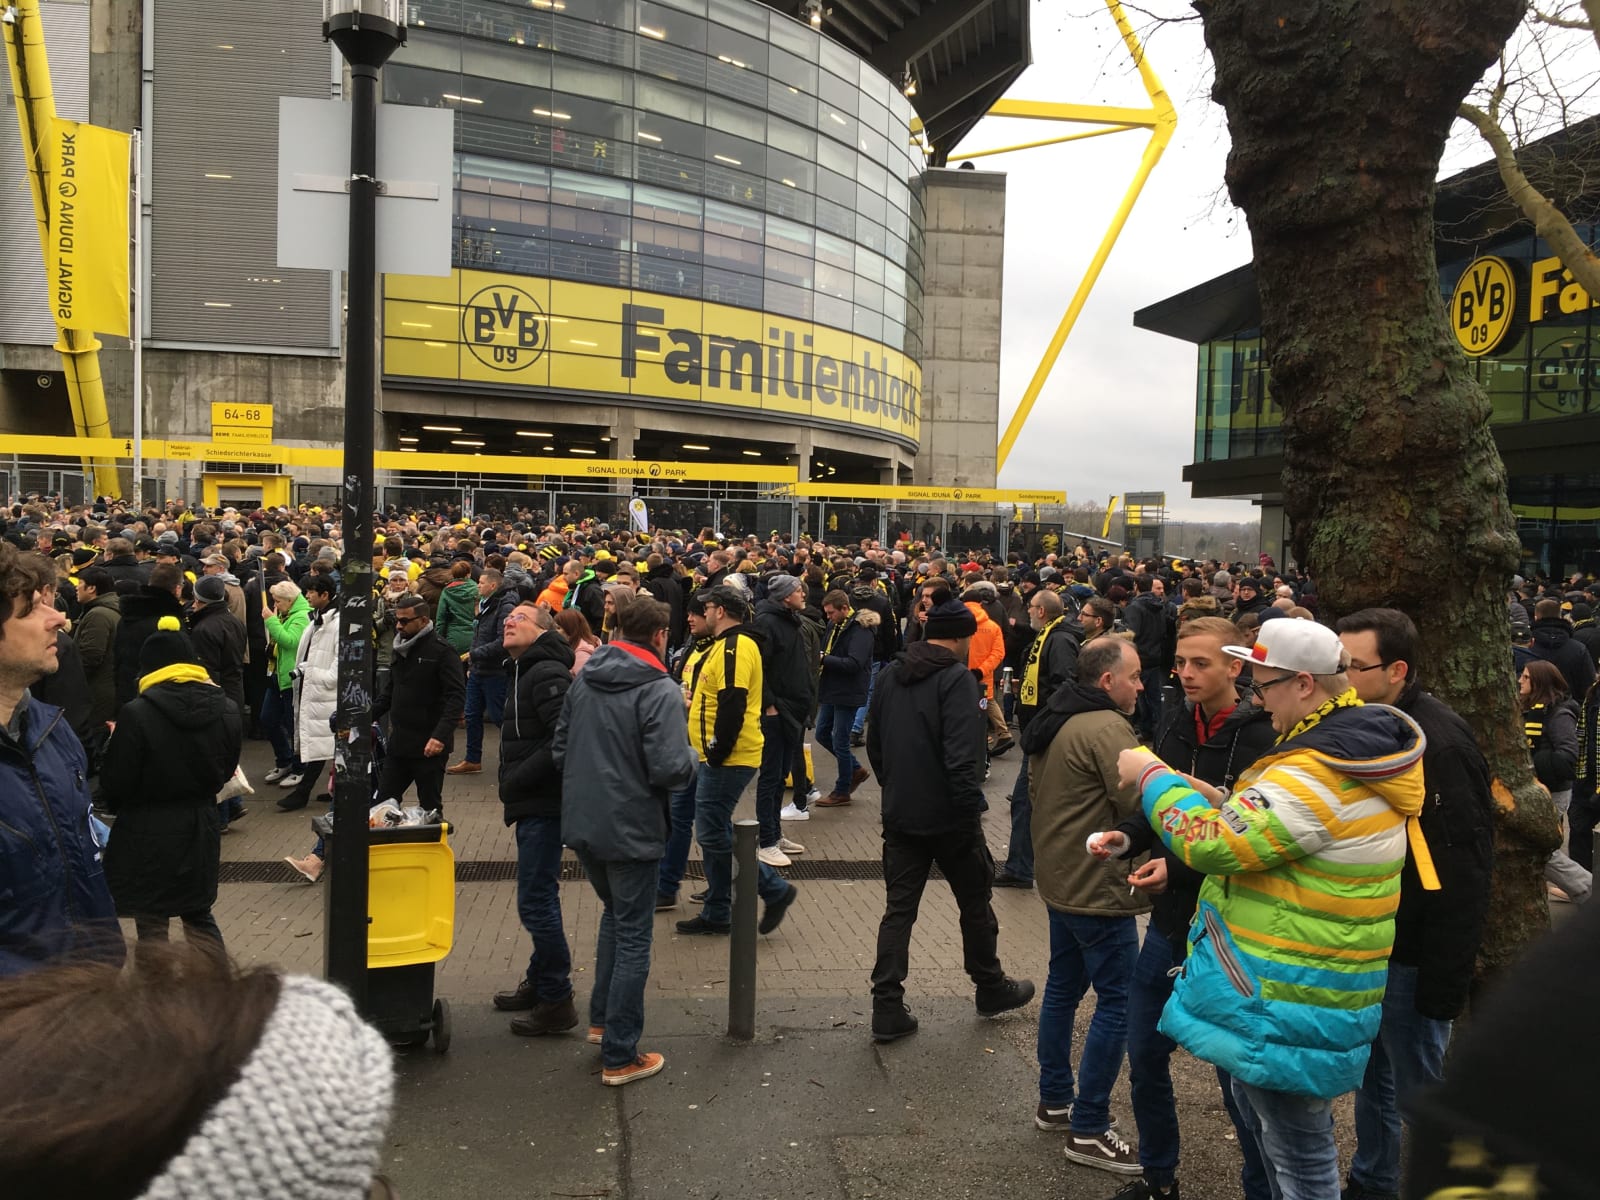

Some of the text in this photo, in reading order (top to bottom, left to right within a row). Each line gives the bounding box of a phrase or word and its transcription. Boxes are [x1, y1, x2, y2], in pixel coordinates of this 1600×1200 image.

[1459, 265, 1505, 330] BVB
[1529, 256, 1600, 323] Fa
[474, 292, 540, 348] BVB
[1471, 323, 1488, 346] 09
[493, 346, 518, 364] 09
[620, 302, 916, 428] Familienblock
[224, 408, 261, 421] 64-68
[205, 448, 272, 458] Schiedsrichterkasse
[587, 466, 617, 474] SIGNAL
[619, 467, 645, 475] IDUNA
[1018, 493, 1056, 501] Sondereingang
